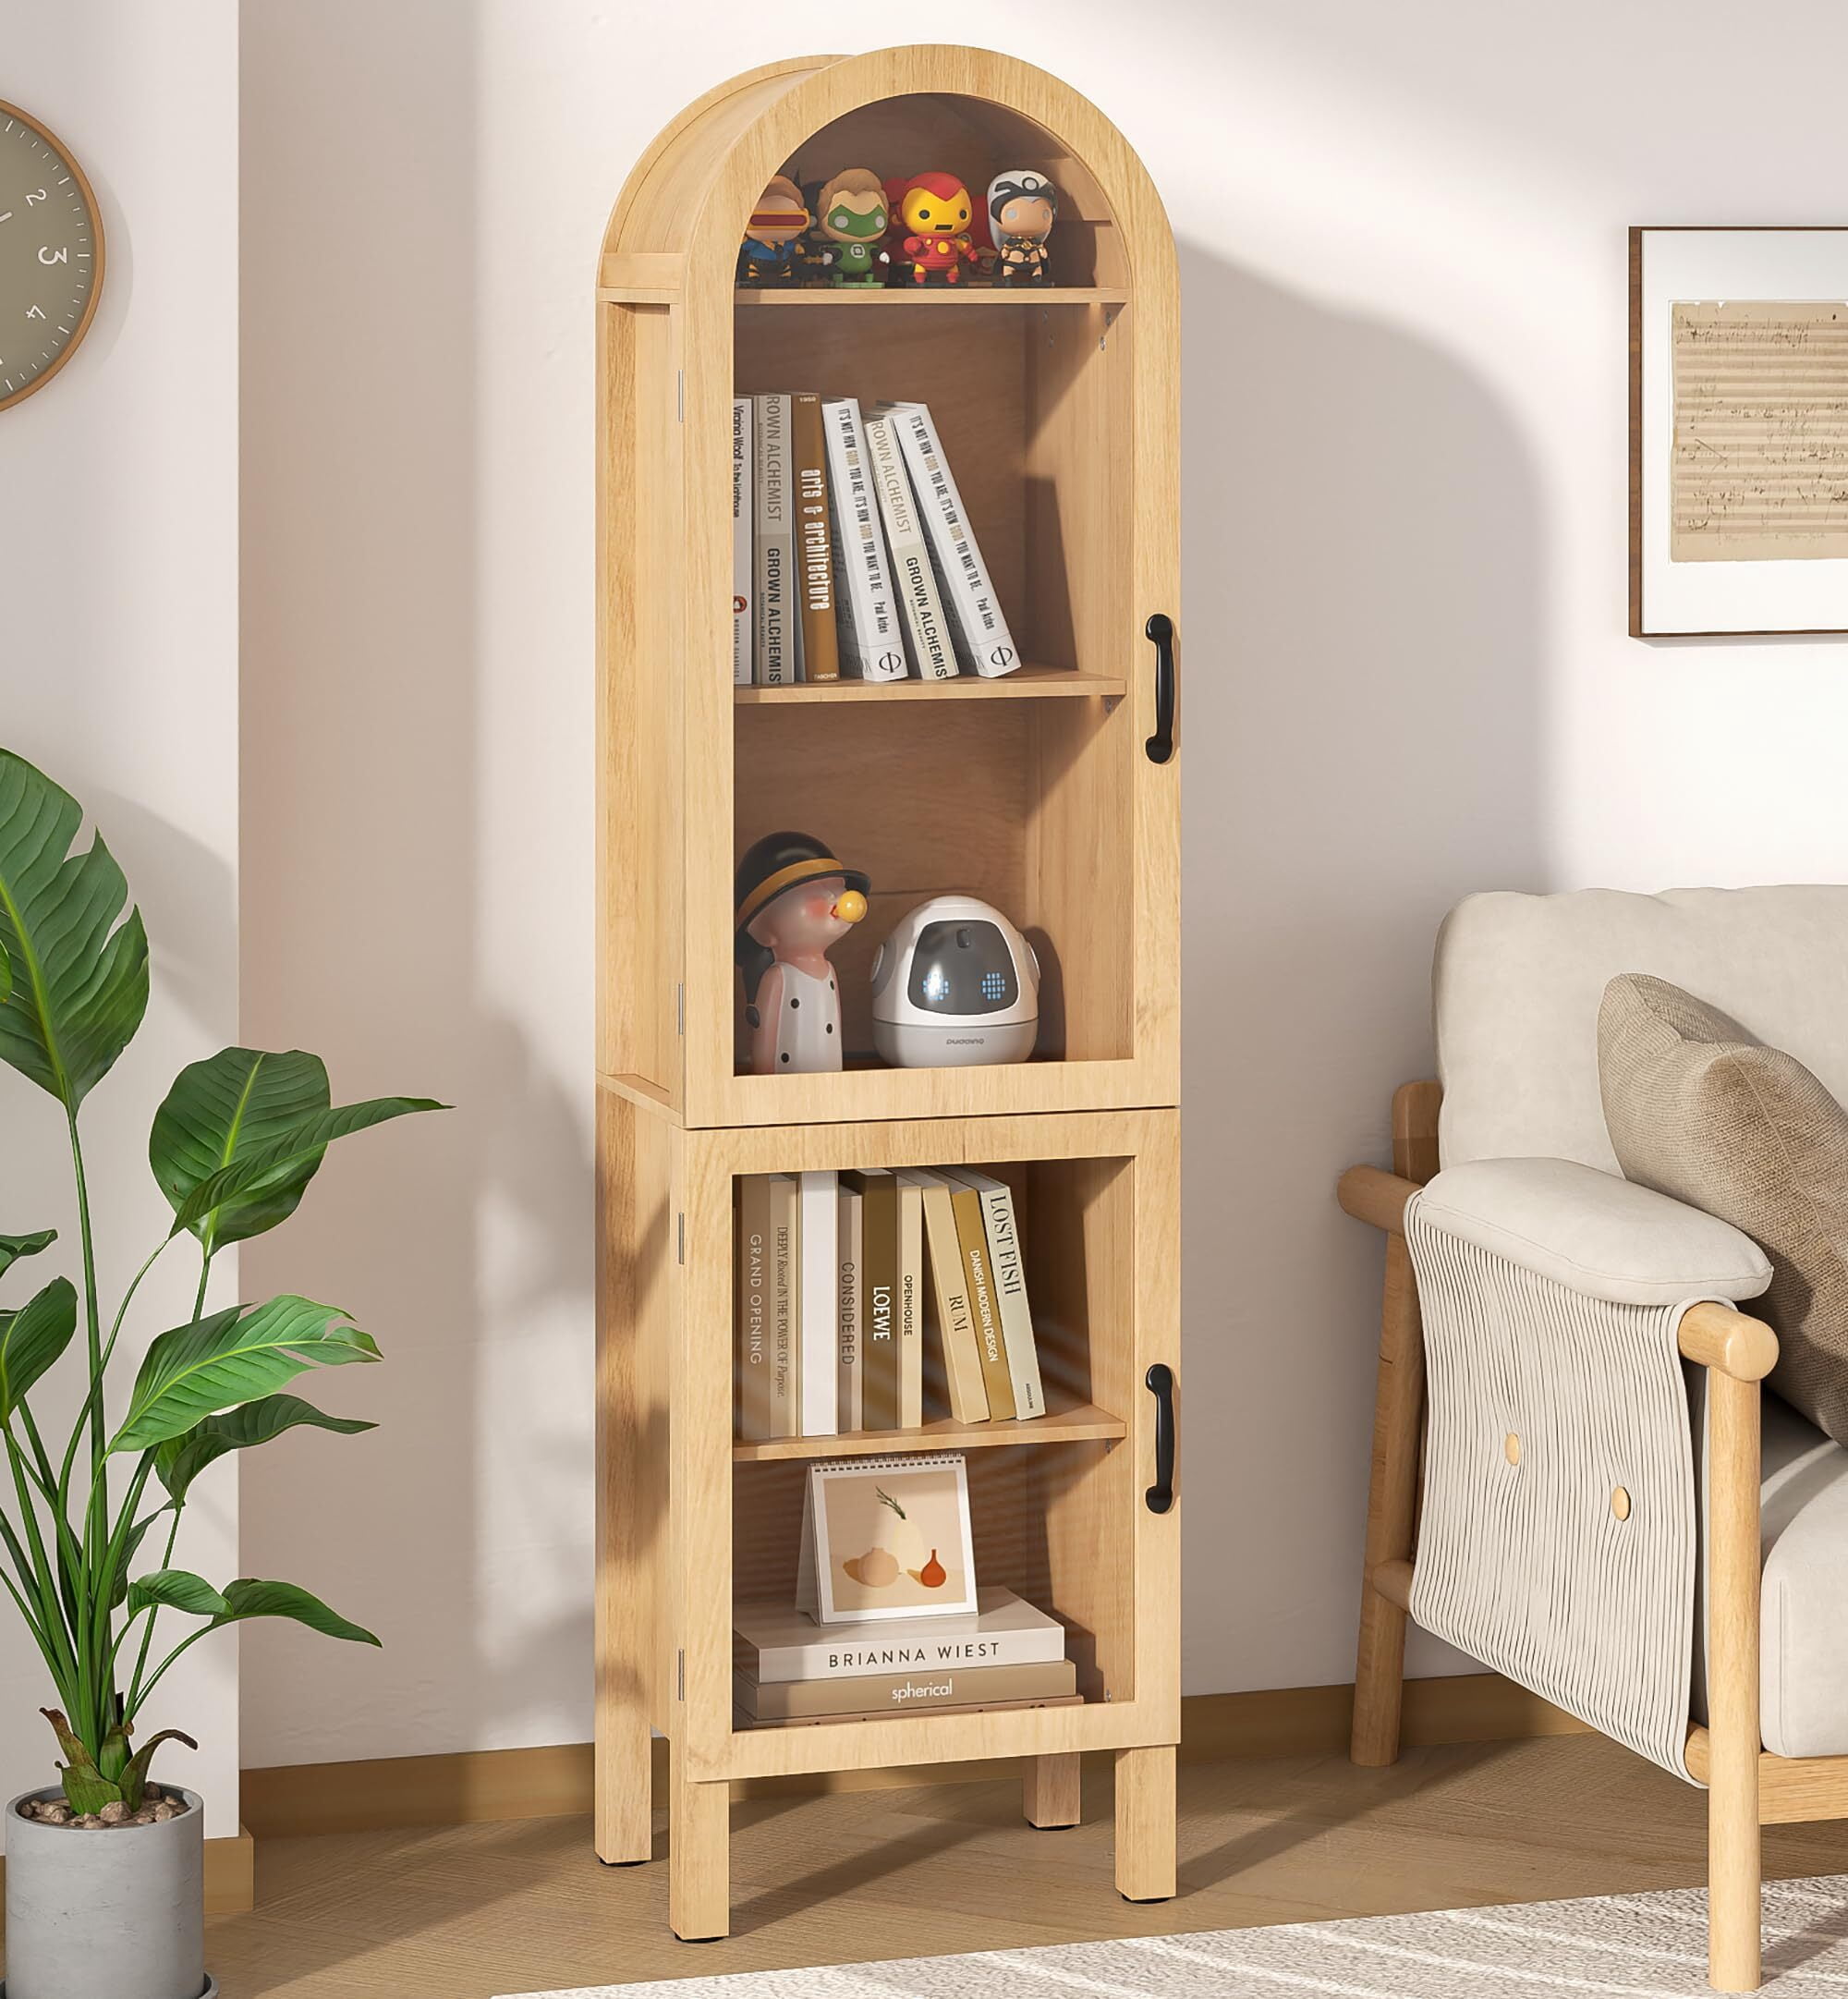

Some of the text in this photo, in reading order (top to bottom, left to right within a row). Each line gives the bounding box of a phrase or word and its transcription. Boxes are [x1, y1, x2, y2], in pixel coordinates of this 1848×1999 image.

[26, 189, 46, 206] 2
[38, 247, 67, 264] 3
[26, 305, 46, 319] 4
[767, 444, 782, 521] ALCHEMIST
[801, 469, 824, 498] arts
[882, 464, 912, 533] ALCHEMIST
[804, 522, 831, 610] architecture
[768, 548, 782, 684] GROWN ALCHEMIS
[906, 557, 948, 679] GROWN ALCHEMIS
[777, 1226, 788, 1259] DEEPLY
[991, 1196, 1021, 1295] LOST FISH
[750, 1234, 762, 1364] GRAND OPENING
[777, 1299, 788, 1317] THE
[842, 1262, 855, 1365] CONSIDERED
[873, 1286, 891, 1341] LOEWE
[904, 1275, 913, 1336] OPENHOUSE
[949, 1295, 968, 1331] RUM
[969, 1249, 999, 1362] DANISH MODERN DESIGN
[777, 1319, 788, 1350] POWER
[777, 1351, 788, 1364] OF
[829, 1642, 1000, 1668] BRIANNA WIEST
[892, 1678, 953, 1703] spherical
